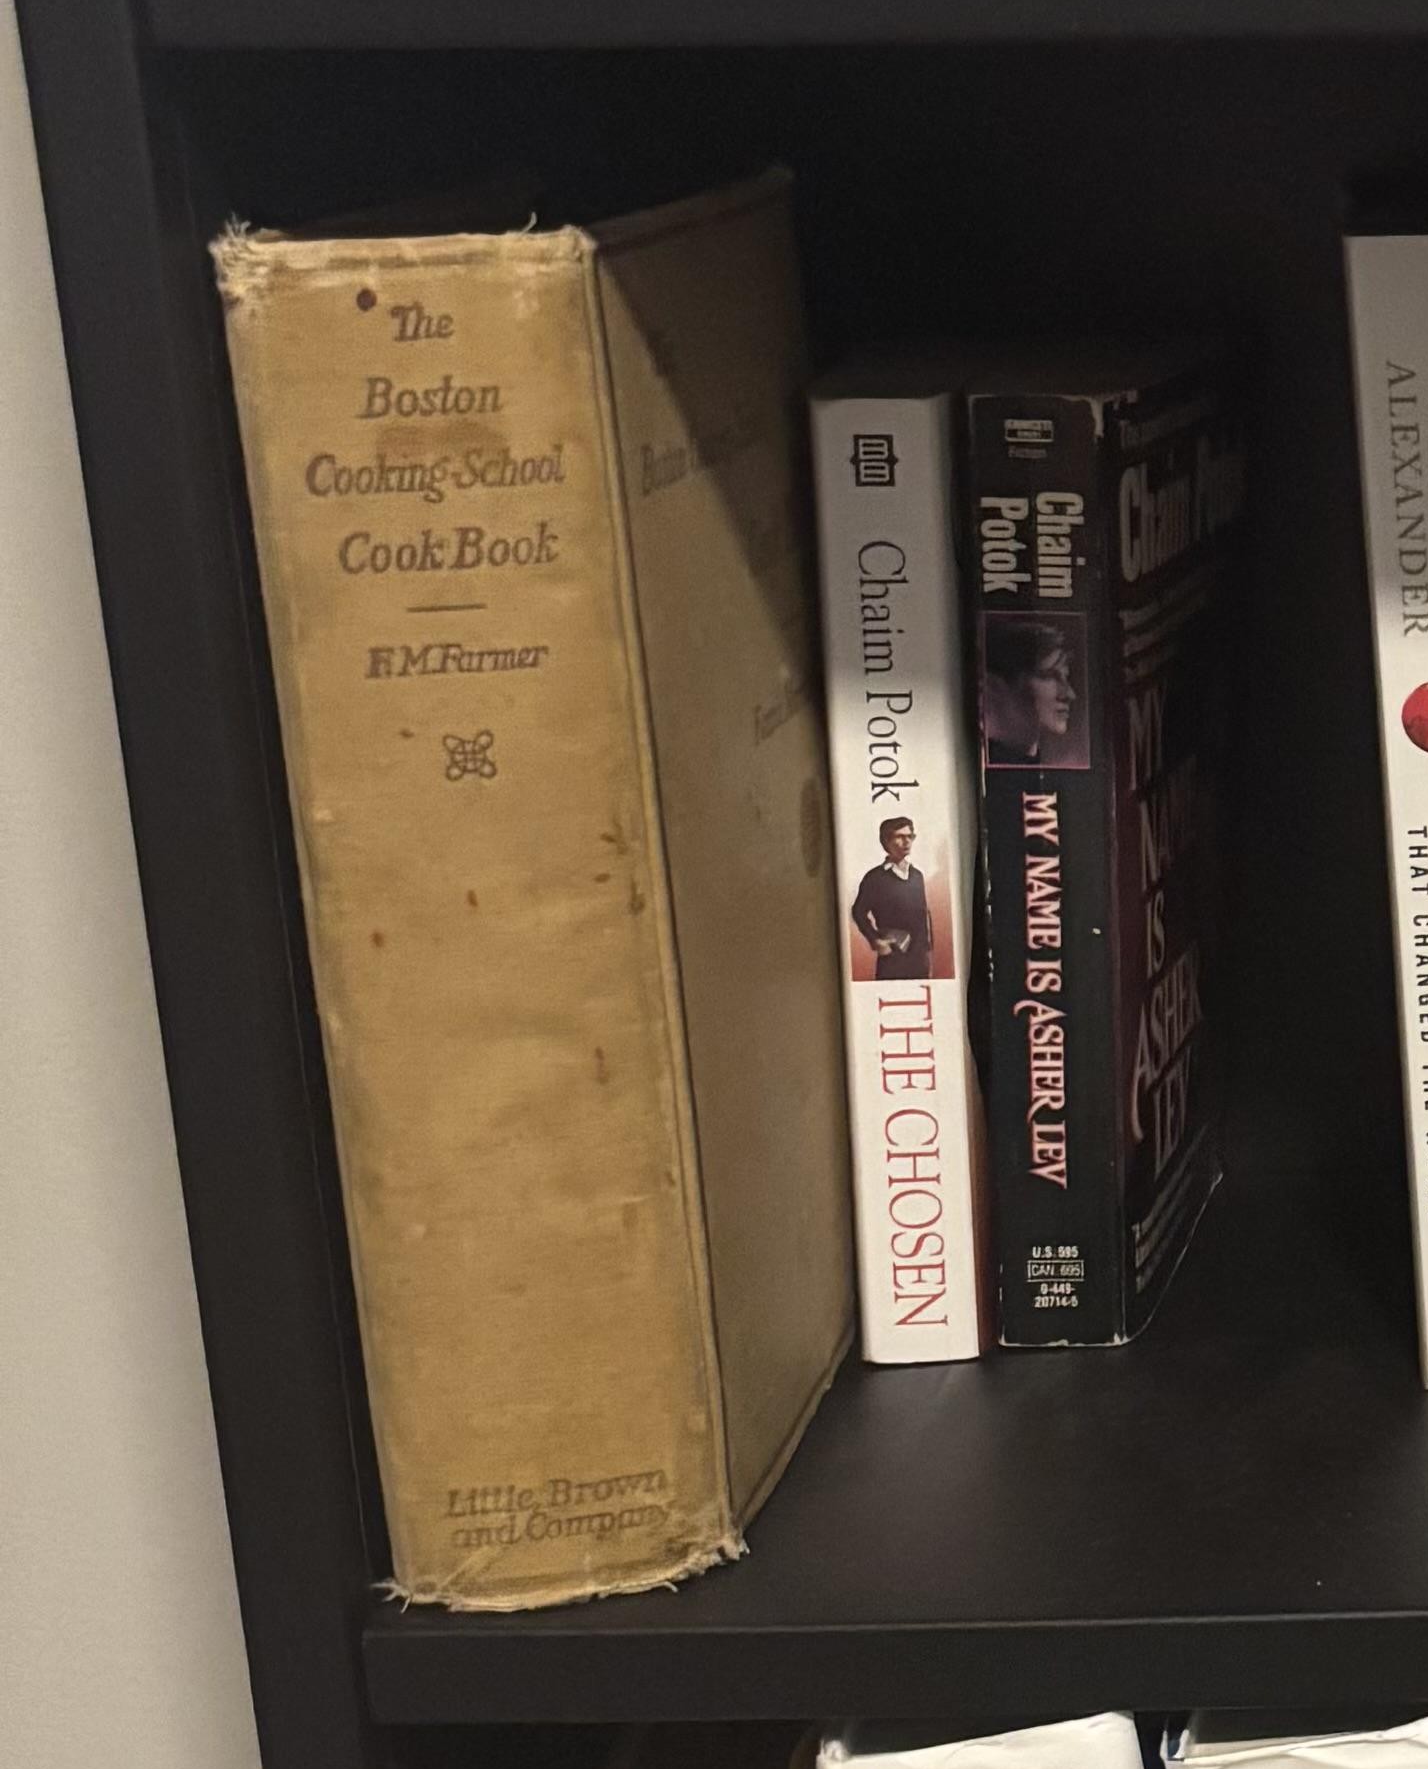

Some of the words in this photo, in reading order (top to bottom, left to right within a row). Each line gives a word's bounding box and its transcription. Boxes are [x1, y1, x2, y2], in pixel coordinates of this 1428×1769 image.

[358, 376, 501, 418] Boston
[980, 496, 1031, 594] Potok
[1036, 491, 1085, 598] Chaim
[856, 540, 909, 677] Chaim
[866, 688, 920, 805] Potok
[546, 1469, 667, 1509] Brown
